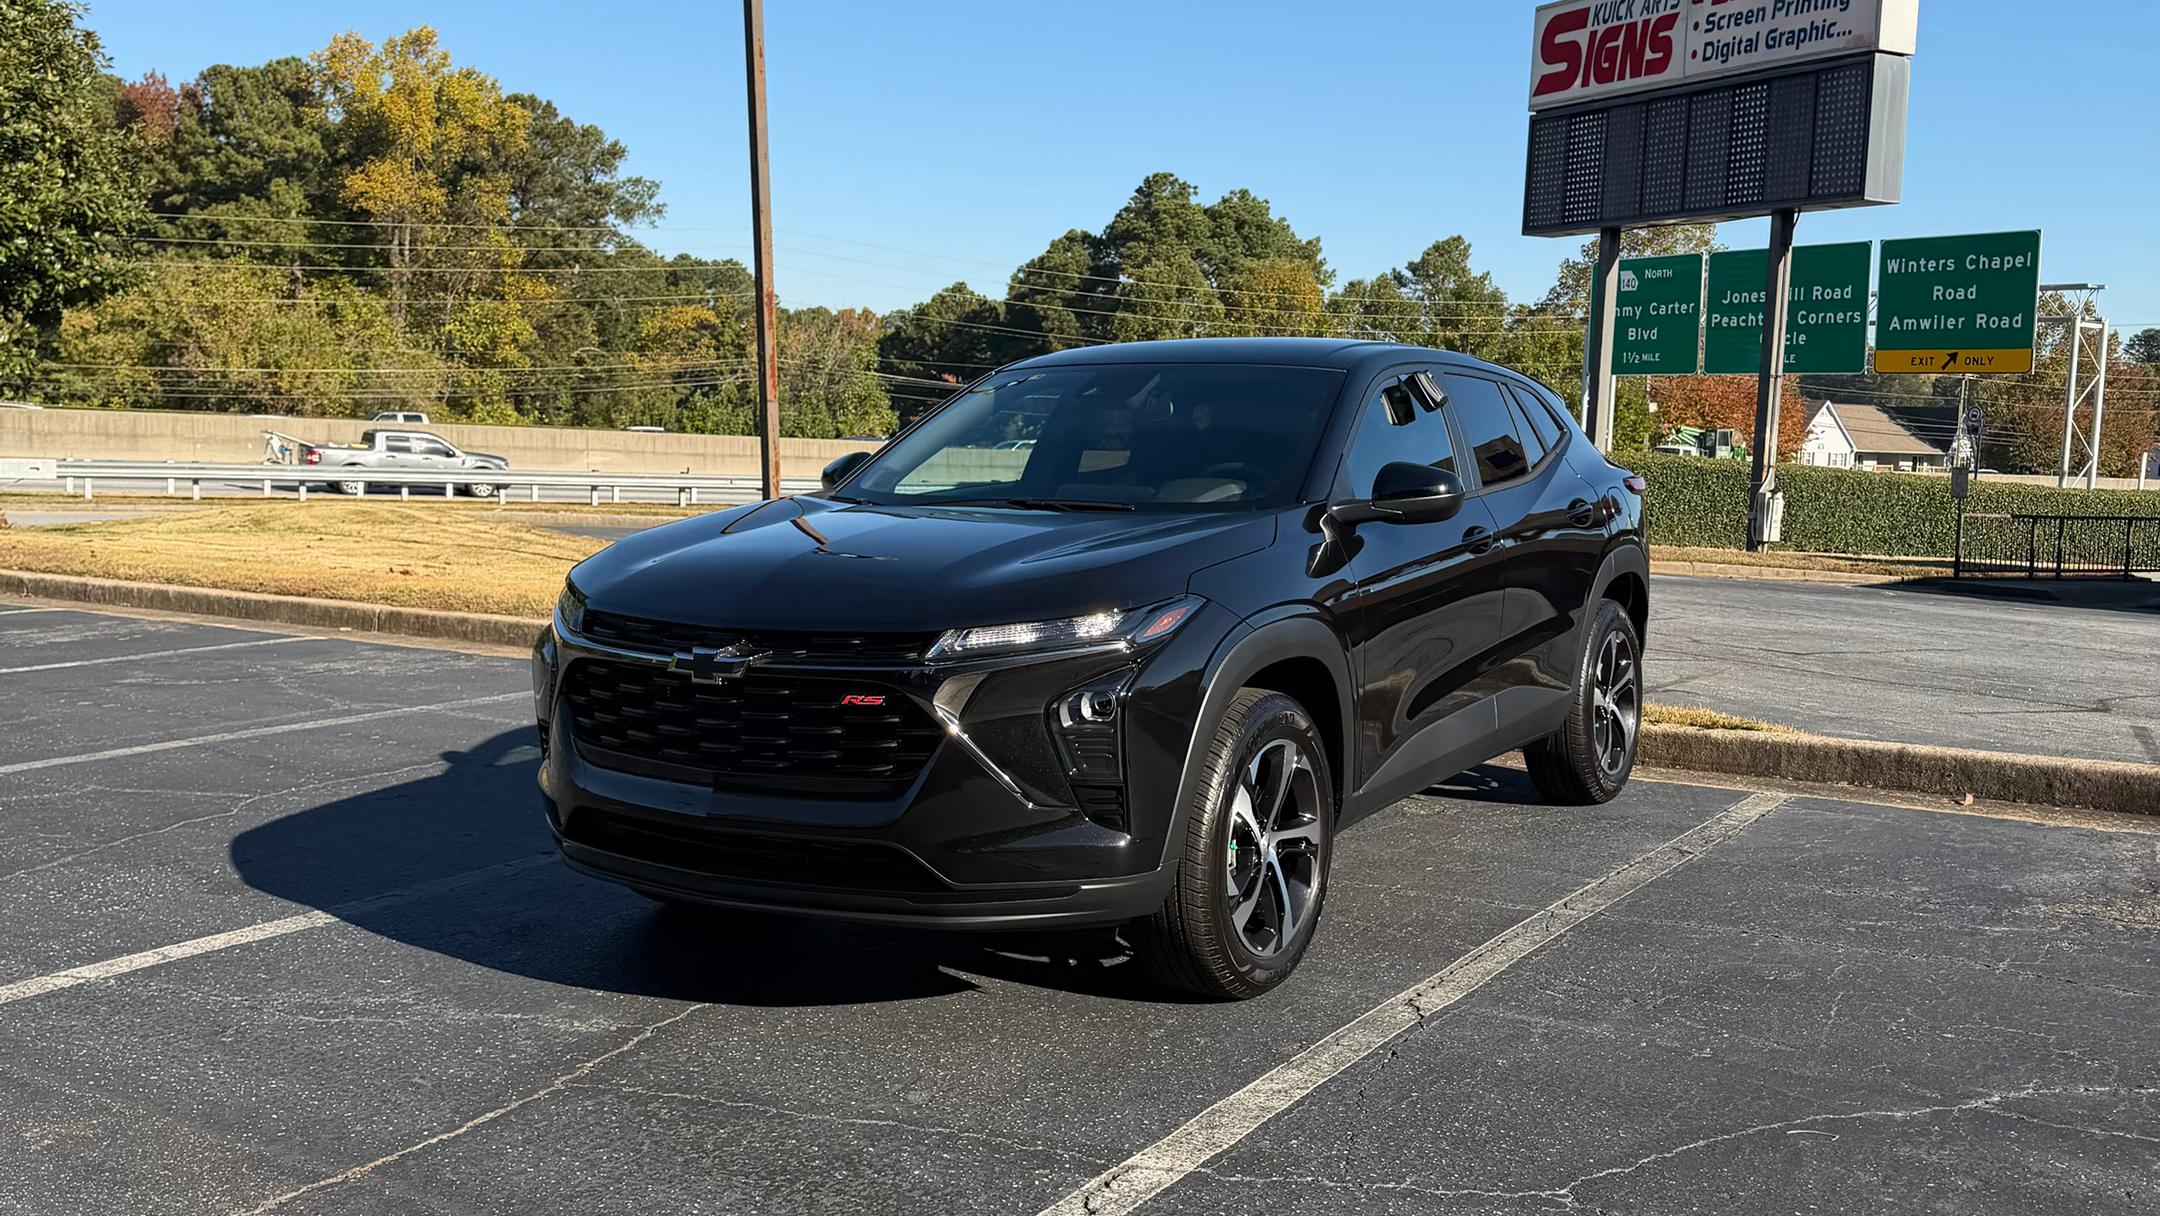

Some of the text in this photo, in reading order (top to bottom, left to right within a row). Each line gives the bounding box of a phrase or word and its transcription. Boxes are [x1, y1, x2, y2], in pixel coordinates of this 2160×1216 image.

[1592, 0, 1635, 27] KUICK
[1704, 6, 1767, 34] Screen
[1532, 6, 1681, 97] SIGNS
[1702, 31, 1760, 64] Digital
[1887, 252, 2032, 274] Winters Chapel
[1644, 269, 1673, 279] NORTH
[1622, 278, 1637, 290] 140
[1721, 285, 1852, 304] Jones ill Road
[1932, 285, 1977, 300] Road
[1649, 301, 1695, 315] Carter
[1711, 310, 1862, 327] Peacht Corners
[1889, 313, 2022, 331] Amwiler Road
[1628, 327, 1658, 341] Blvd
[1641, 353, 1660, 362] MILE
[1911, 356, 1994, 366] EXIT ONLY
[841, 695, 885, 705] RS
